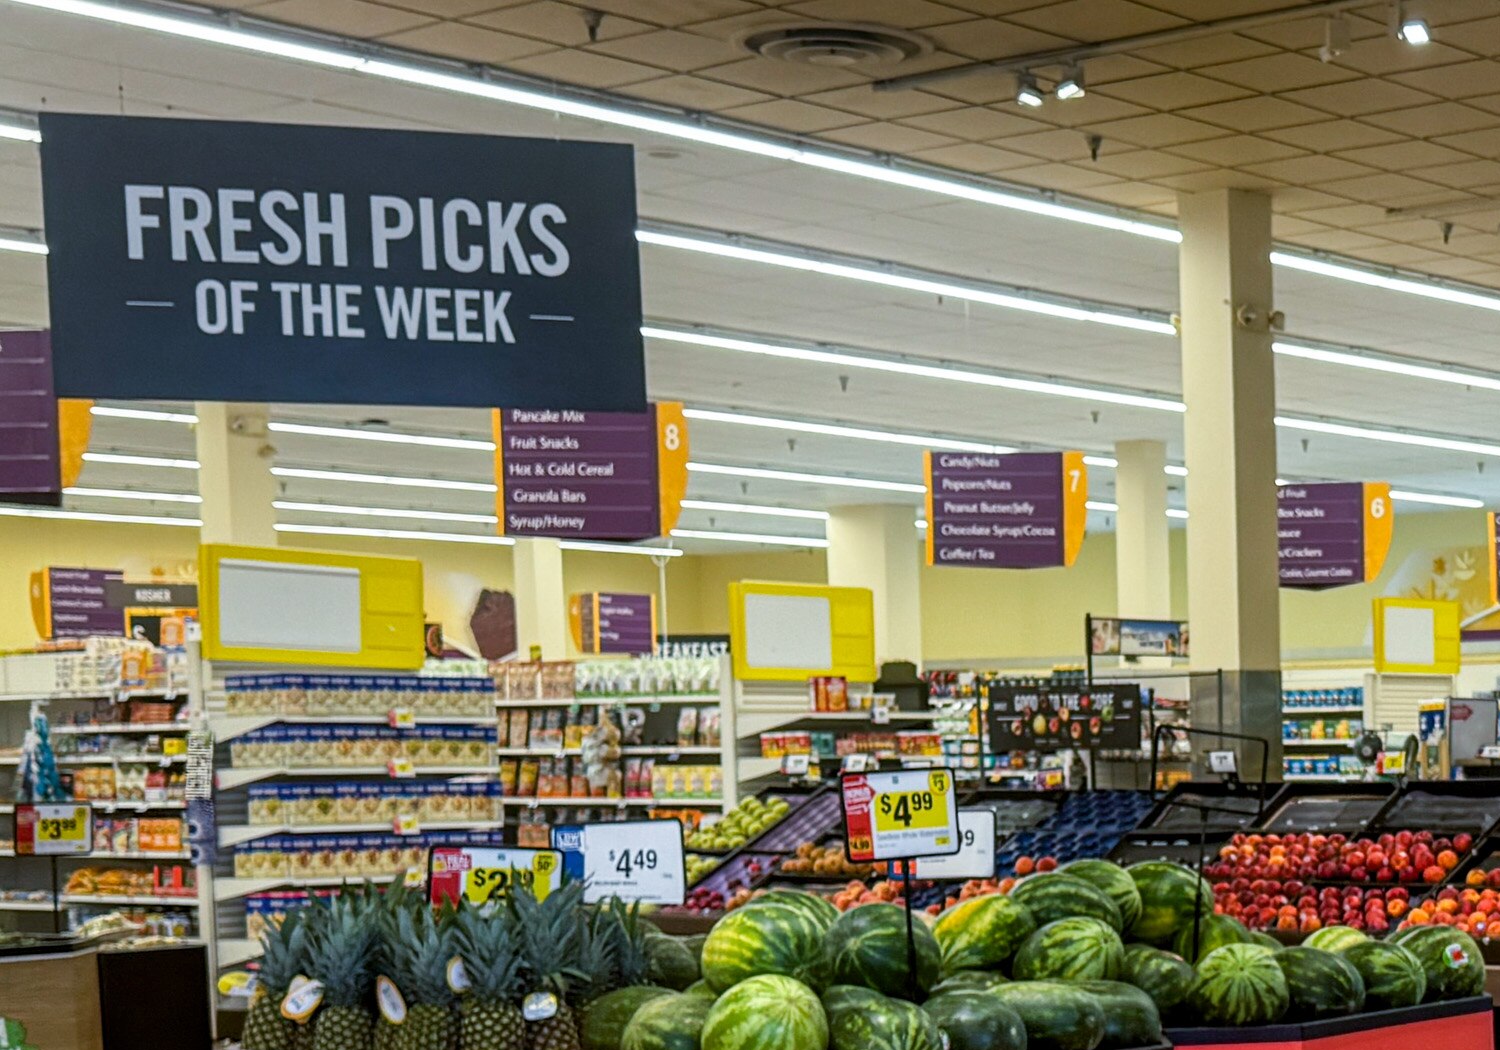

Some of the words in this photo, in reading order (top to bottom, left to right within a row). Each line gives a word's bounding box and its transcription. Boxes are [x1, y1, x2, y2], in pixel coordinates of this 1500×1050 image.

[124, 184, 349, 267] FRESH
[370, 194, 570, 277] PICKS
[195, 279, 258, 334] OF
[271, 281, 365, 338] THE
[375, 286, 516, 343] WEEK
[512, 409, 559, 423] Pancake
[562, 410, 585, 423] Mix
[510, 436, 537, 450] Fruit
[539, 436, 580, 450] Snacks
[664, 423, 681, 451] 8
[940, 454, 1000, 469] Candy/Nuts
[509, 463, 532, 476] Hot
[534, 464, 544, 476] &
[548, 462, 575, 477] Cold
[577, 462, 614, 477] Cereal
[942, 478, 1012, 492] Popcorn/Nuts
[1069, 470, 1080, 493] 7
[513, 489, 559, 503] Granola
[561, 489, 587, 503] Bars
[1371, 497, 1385, 519] 6
[509, 515, 585, 531] Syrup/Honey
[941, 524, 990, 537] Chocolate
